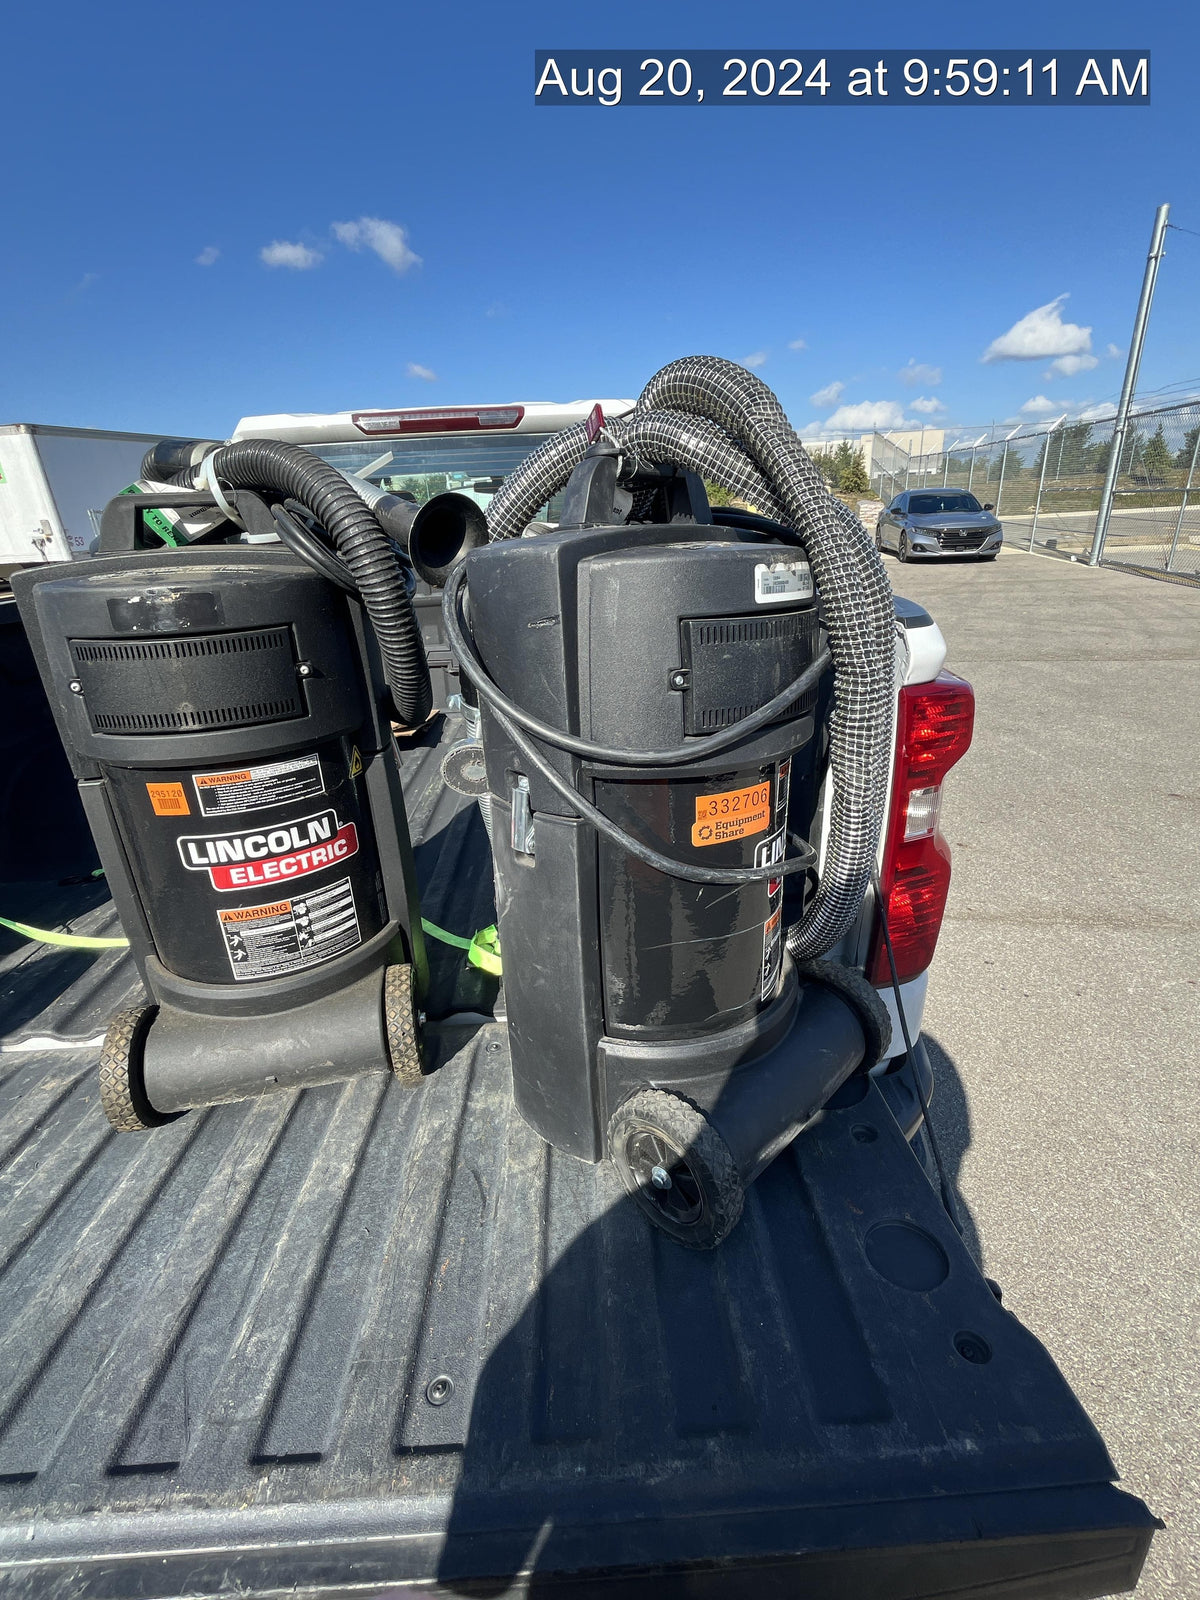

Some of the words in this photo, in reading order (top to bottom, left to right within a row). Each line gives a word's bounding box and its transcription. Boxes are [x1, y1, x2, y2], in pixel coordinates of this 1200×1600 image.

[208, 773, 247, 784] WARNING
[150, 789, 183, 798] 295120
[708, 787, 768, 816] 332706
[714, 809, 766, 831] Equipment
[187, 816, 332, 865] LINCOLN
[714, 826, 745, 840] Share
[229, 838, 349, 885] ELECTRIC
[233, 903, 289, 920] WARNING
